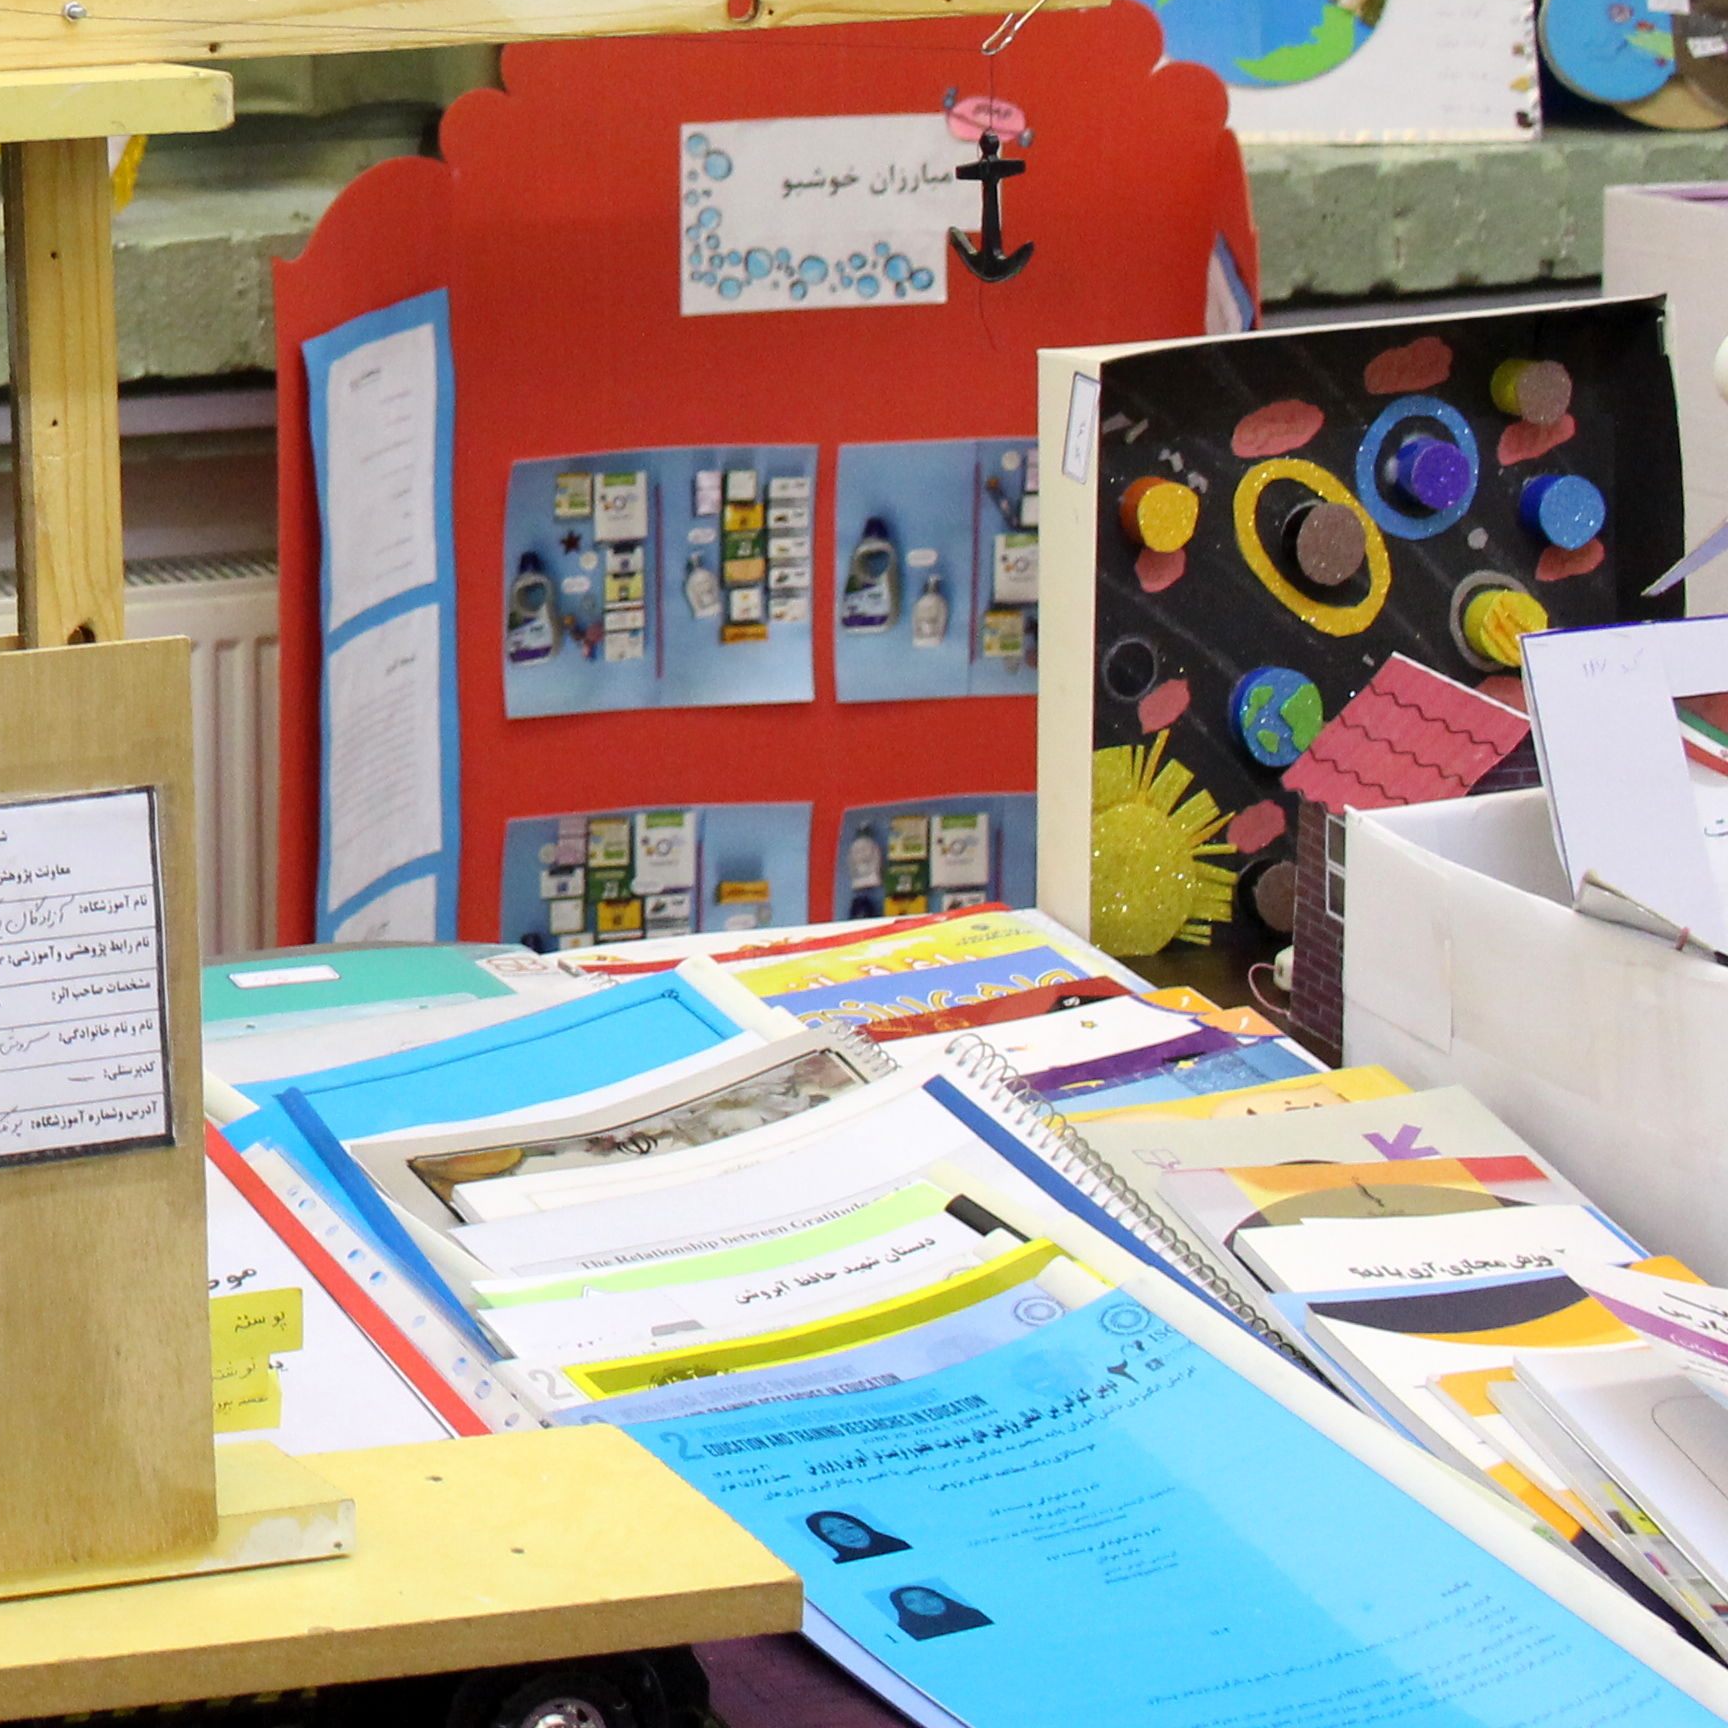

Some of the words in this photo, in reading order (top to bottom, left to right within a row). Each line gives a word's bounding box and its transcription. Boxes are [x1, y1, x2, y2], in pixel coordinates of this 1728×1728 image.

[783, 170, 859, 198] خوشبو
[869, 163, 956, 195] مبارزان
[35, 865, 70, 880] معاونت
[76, 894, 129, 914] آموزشگاه:
[134, 896, 147, 909] نام
[65, 943, 106, 960] پژوهشی
[110, 940, 133, 953] رابط
[136, 937, 149, 951] نام
[72, 985, 103, 1000] صاحب
[107, 979, 150, 993] مشخصات
[52, 987, 69, 1004] اثر:
[56, 1021, 110, 1045] خانوادگی:
[114, 1022, 128, 1037] نام
[132, 1026, 136, 1034] و
[139, 1020, 153, 1033] نام
[28, 1110, 84, 1129] آموزشگاه:
[126, 1101, 157, 1120] آدرس
[720, 1224, 788, 1248] between
[885, 1235, 937, 1266] دبستان
[843, 1254, 881, 1279] شهید
[795, 1270, 837, 1288] حافظ
[703, 1437, 764, 1458] EDUCATION
[766, 1433, 791, 1448] AND
[793, 1423, 841, 1445] TRAINING
[842, 1412, 906, 1438] RESEARCHES
[910, 1411, 924, 1426] IN
[927, 1393, 991, 1423] EDUCATION
[659, 1430, 705, 1463] 2
